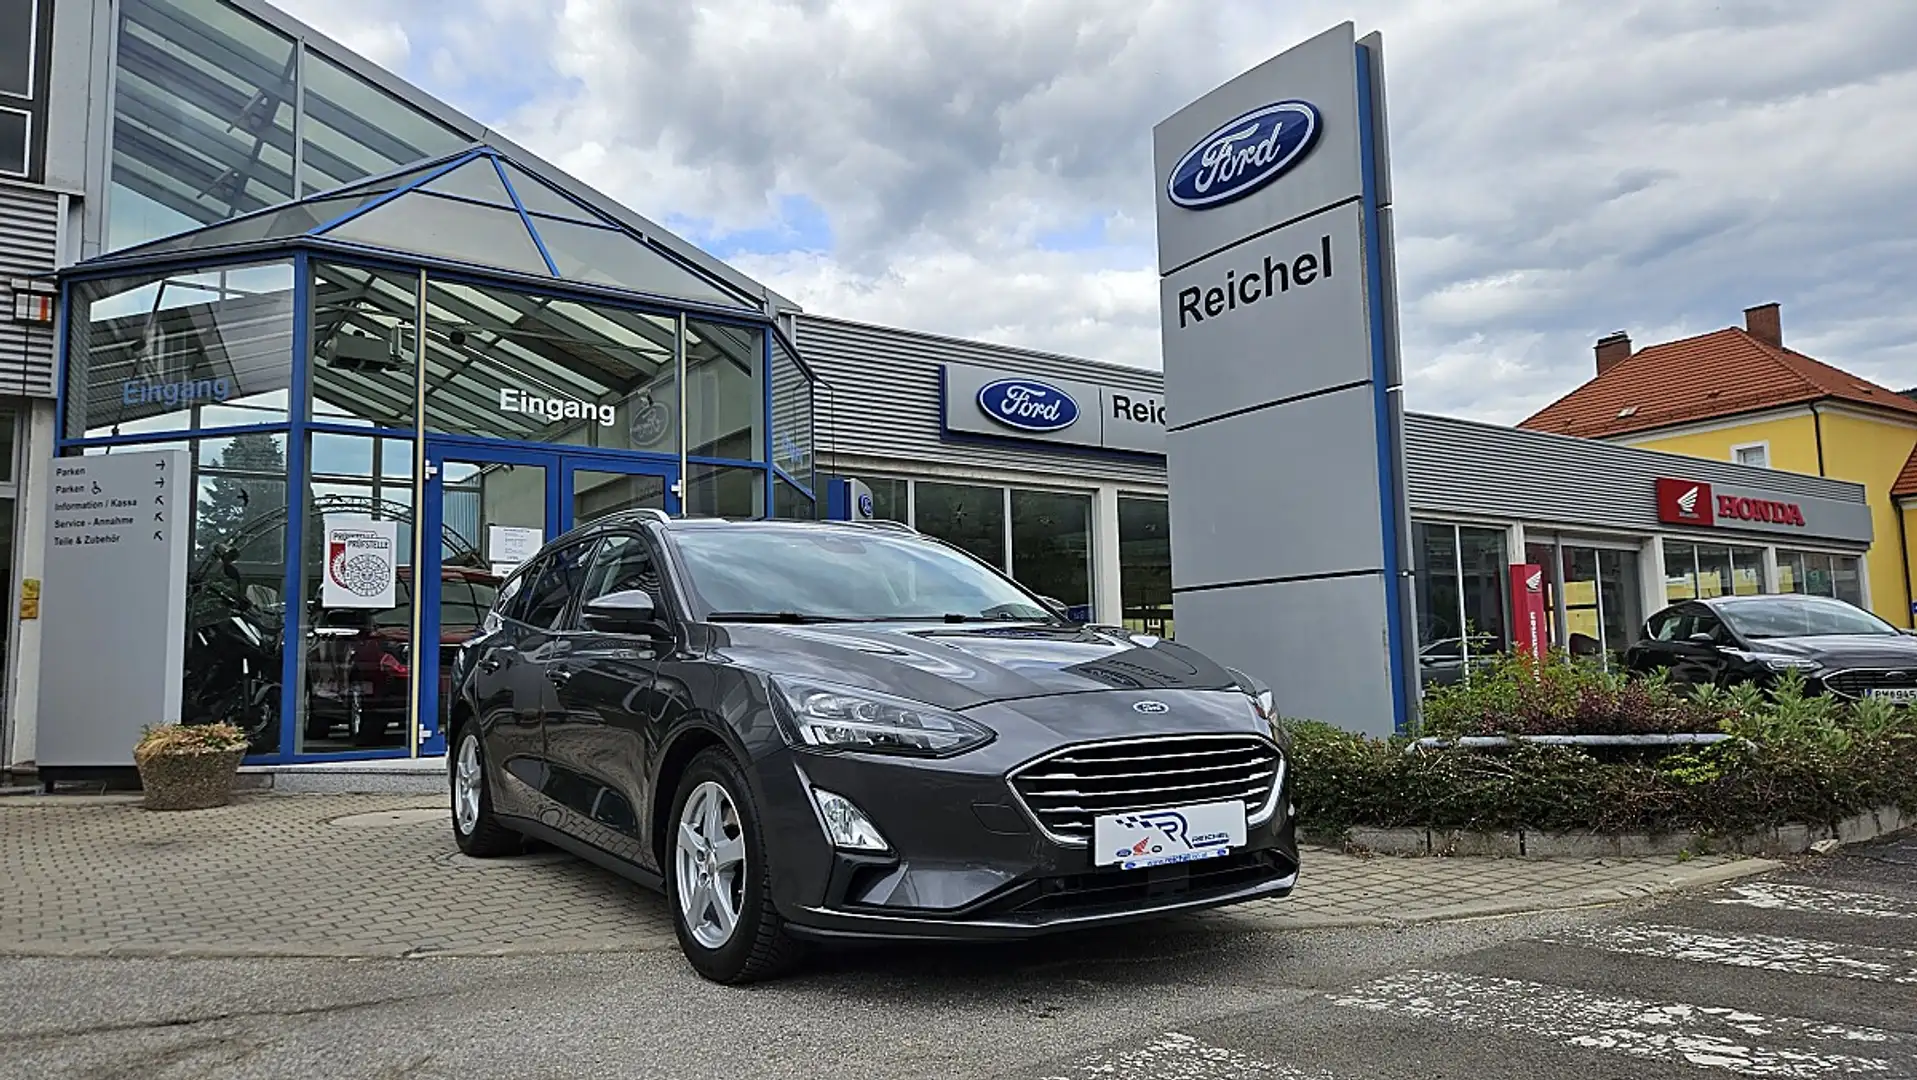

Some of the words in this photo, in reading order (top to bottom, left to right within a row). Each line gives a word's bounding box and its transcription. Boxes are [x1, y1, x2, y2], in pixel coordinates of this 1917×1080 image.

[1195, 122, 1283, 193] Ford
[1178, 235, 1333, 329] Reichel
[122, 378, 229, 406] Eingang
[1000, 385, 1061, 421] Ford
[500, 388, 615, 427] Eingang
[56, 467, 86, 477] Parken
[56, 485, 85, 495] Parken
[55, 502, 103, 511] Information
[111, 498, 137, 508] Kassa
[1716, 494, 1806, 527] HONDA
[54, 519, 85, 529] Service
[94, 517, 134, 526] Annahme
[55, 536, 73, 546] Teile
[84, 534, 120, 545] Zubehör
